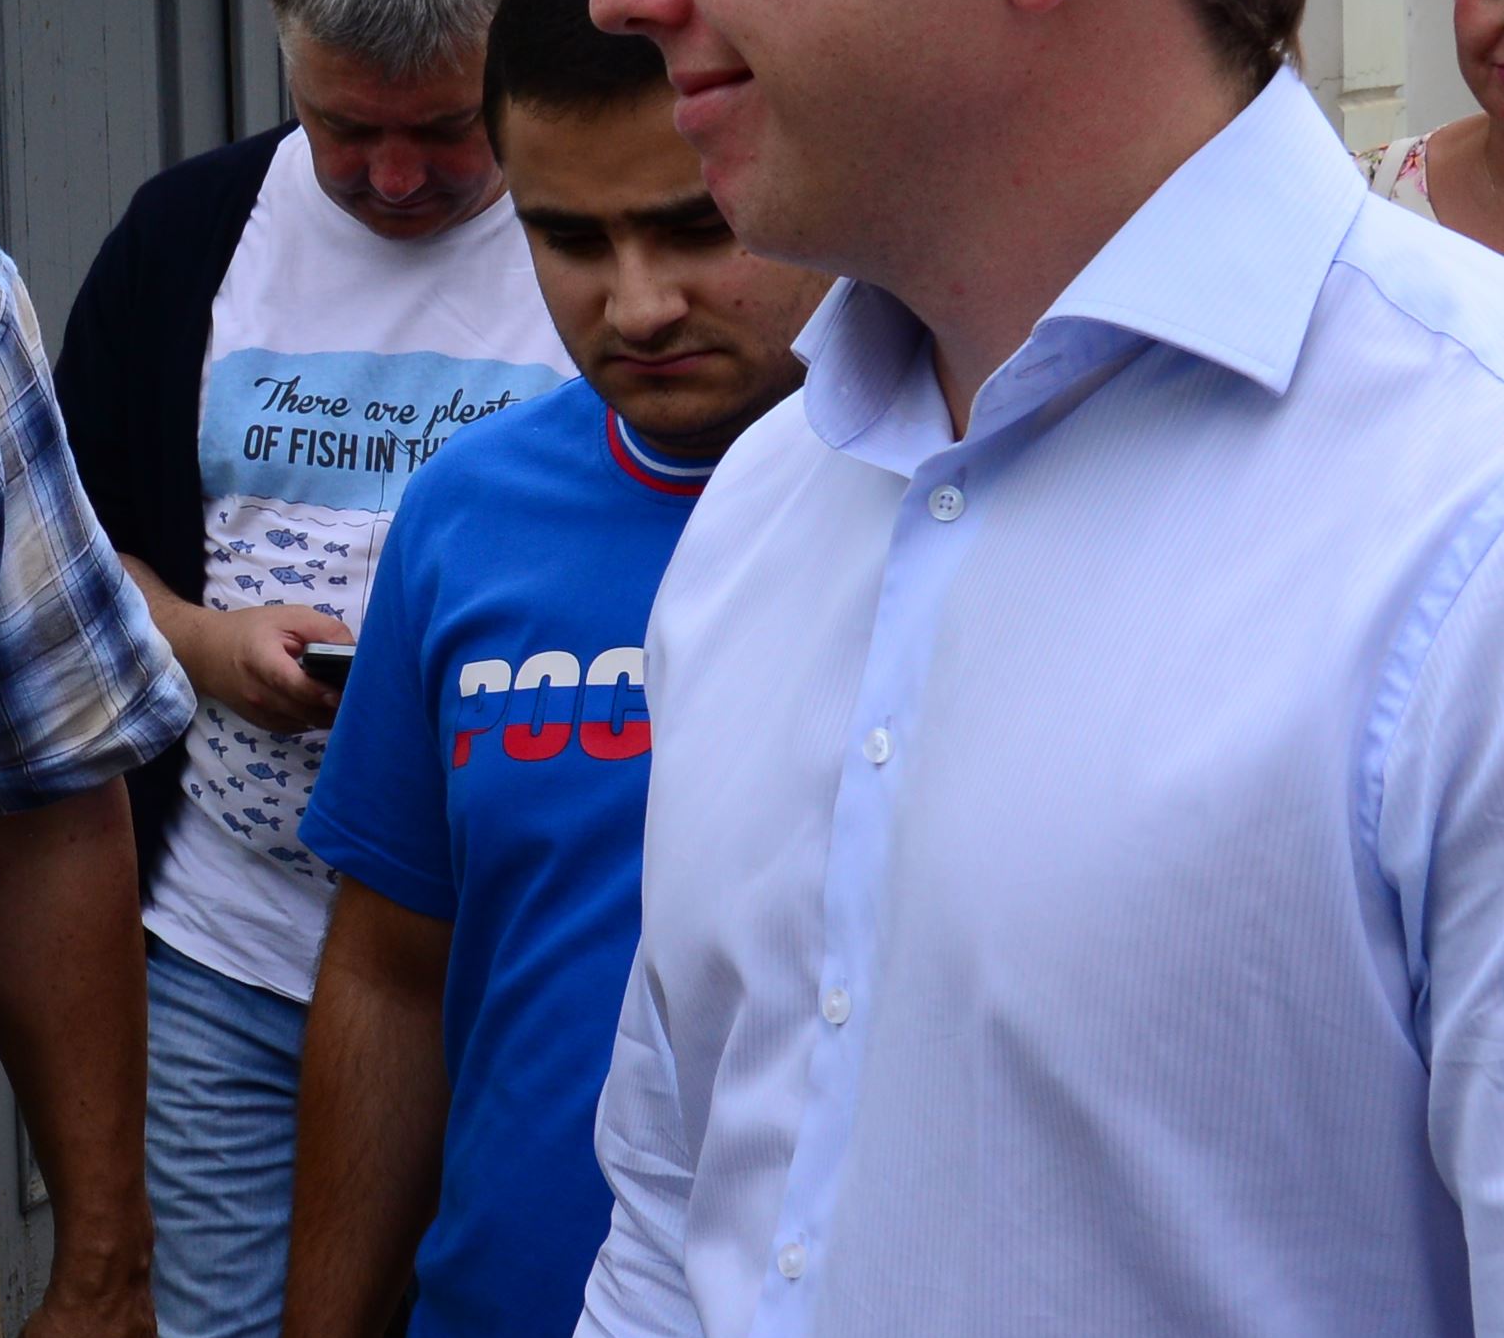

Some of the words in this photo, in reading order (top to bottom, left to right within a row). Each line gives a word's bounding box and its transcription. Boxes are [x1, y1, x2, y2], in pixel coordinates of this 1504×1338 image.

[254, 375, 352, 415] There
[364, 401, 420, 425] are
[422, 388, 522, 439] plent
[243, 424, 283, 462] OF
[288, 427, 358, 471] FISH
[365, 436, 394, 473] IN
[405, 437, 448, 474] TH
[451, 646, 652, 770] РОС
